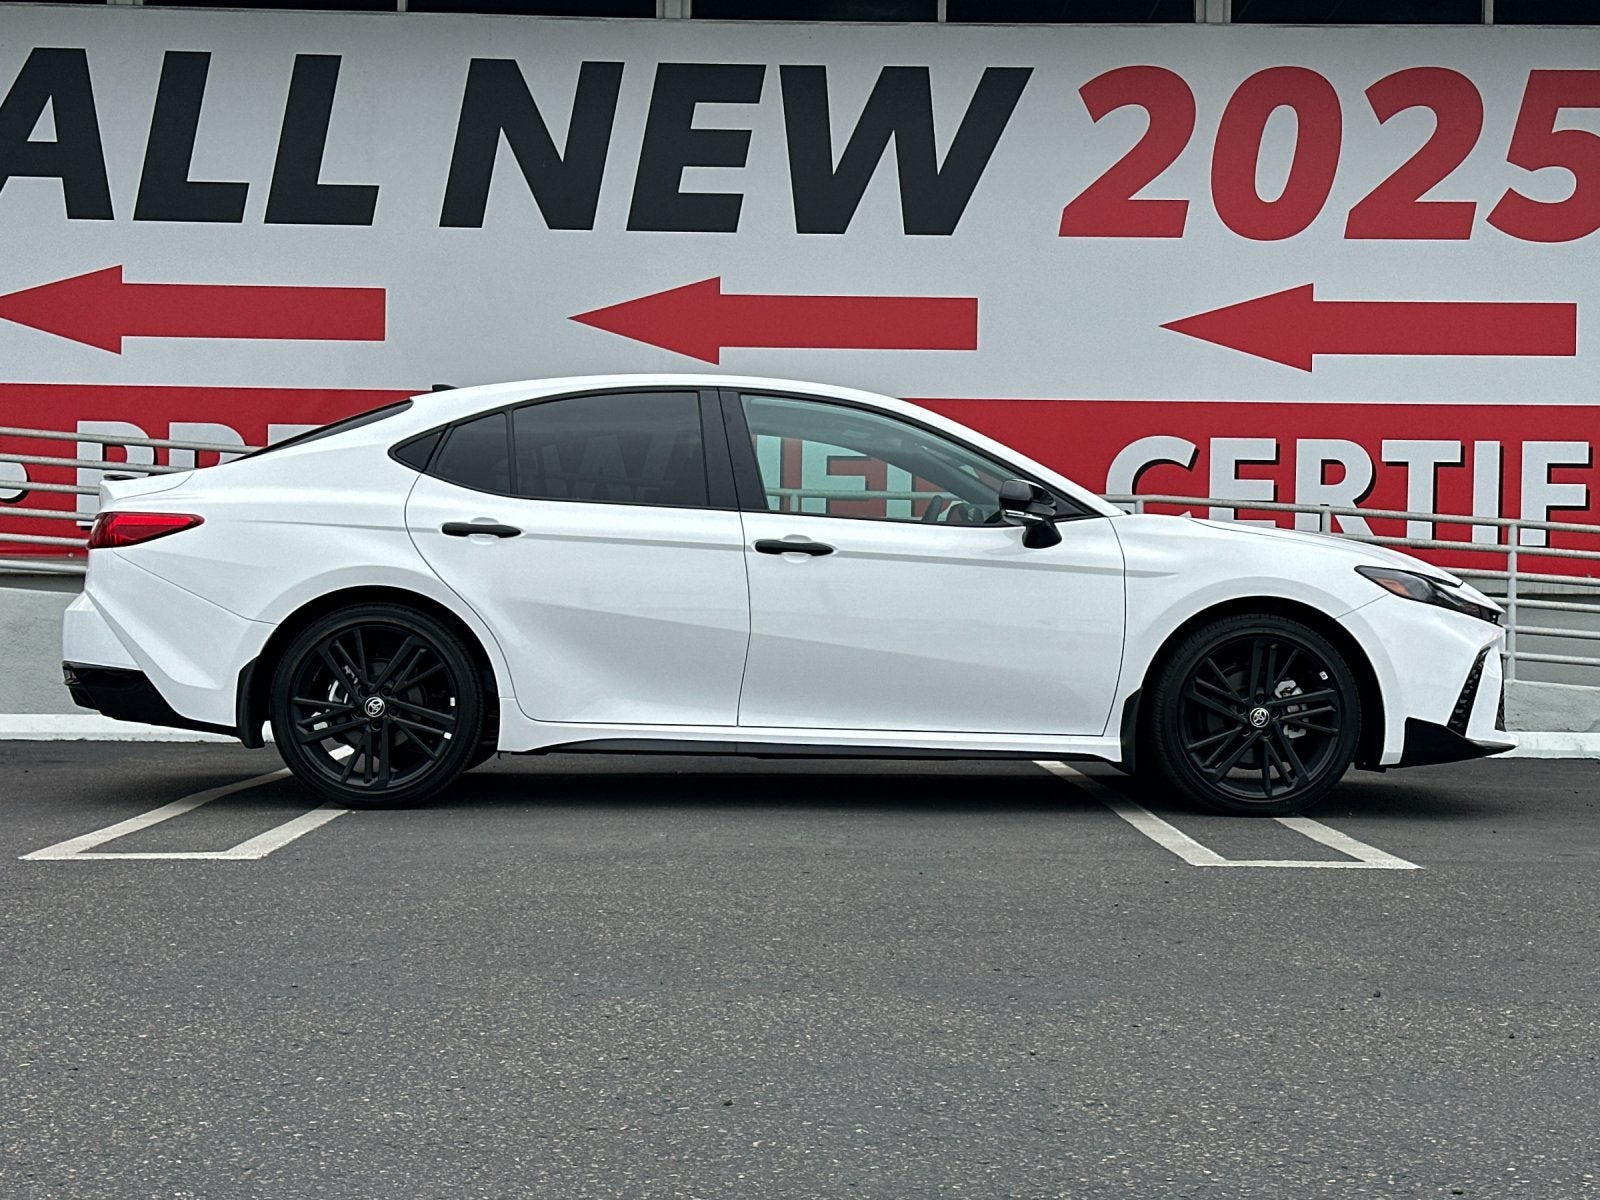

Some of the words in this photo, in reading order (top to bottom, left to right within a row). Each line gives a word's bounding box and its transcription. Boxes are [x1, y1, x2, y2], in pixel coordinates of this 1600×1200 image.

[0, 47, 380, 226] ALL
[439, 58, 1035, 236] NEW
[1058, 65, 1600, 243] 2025
